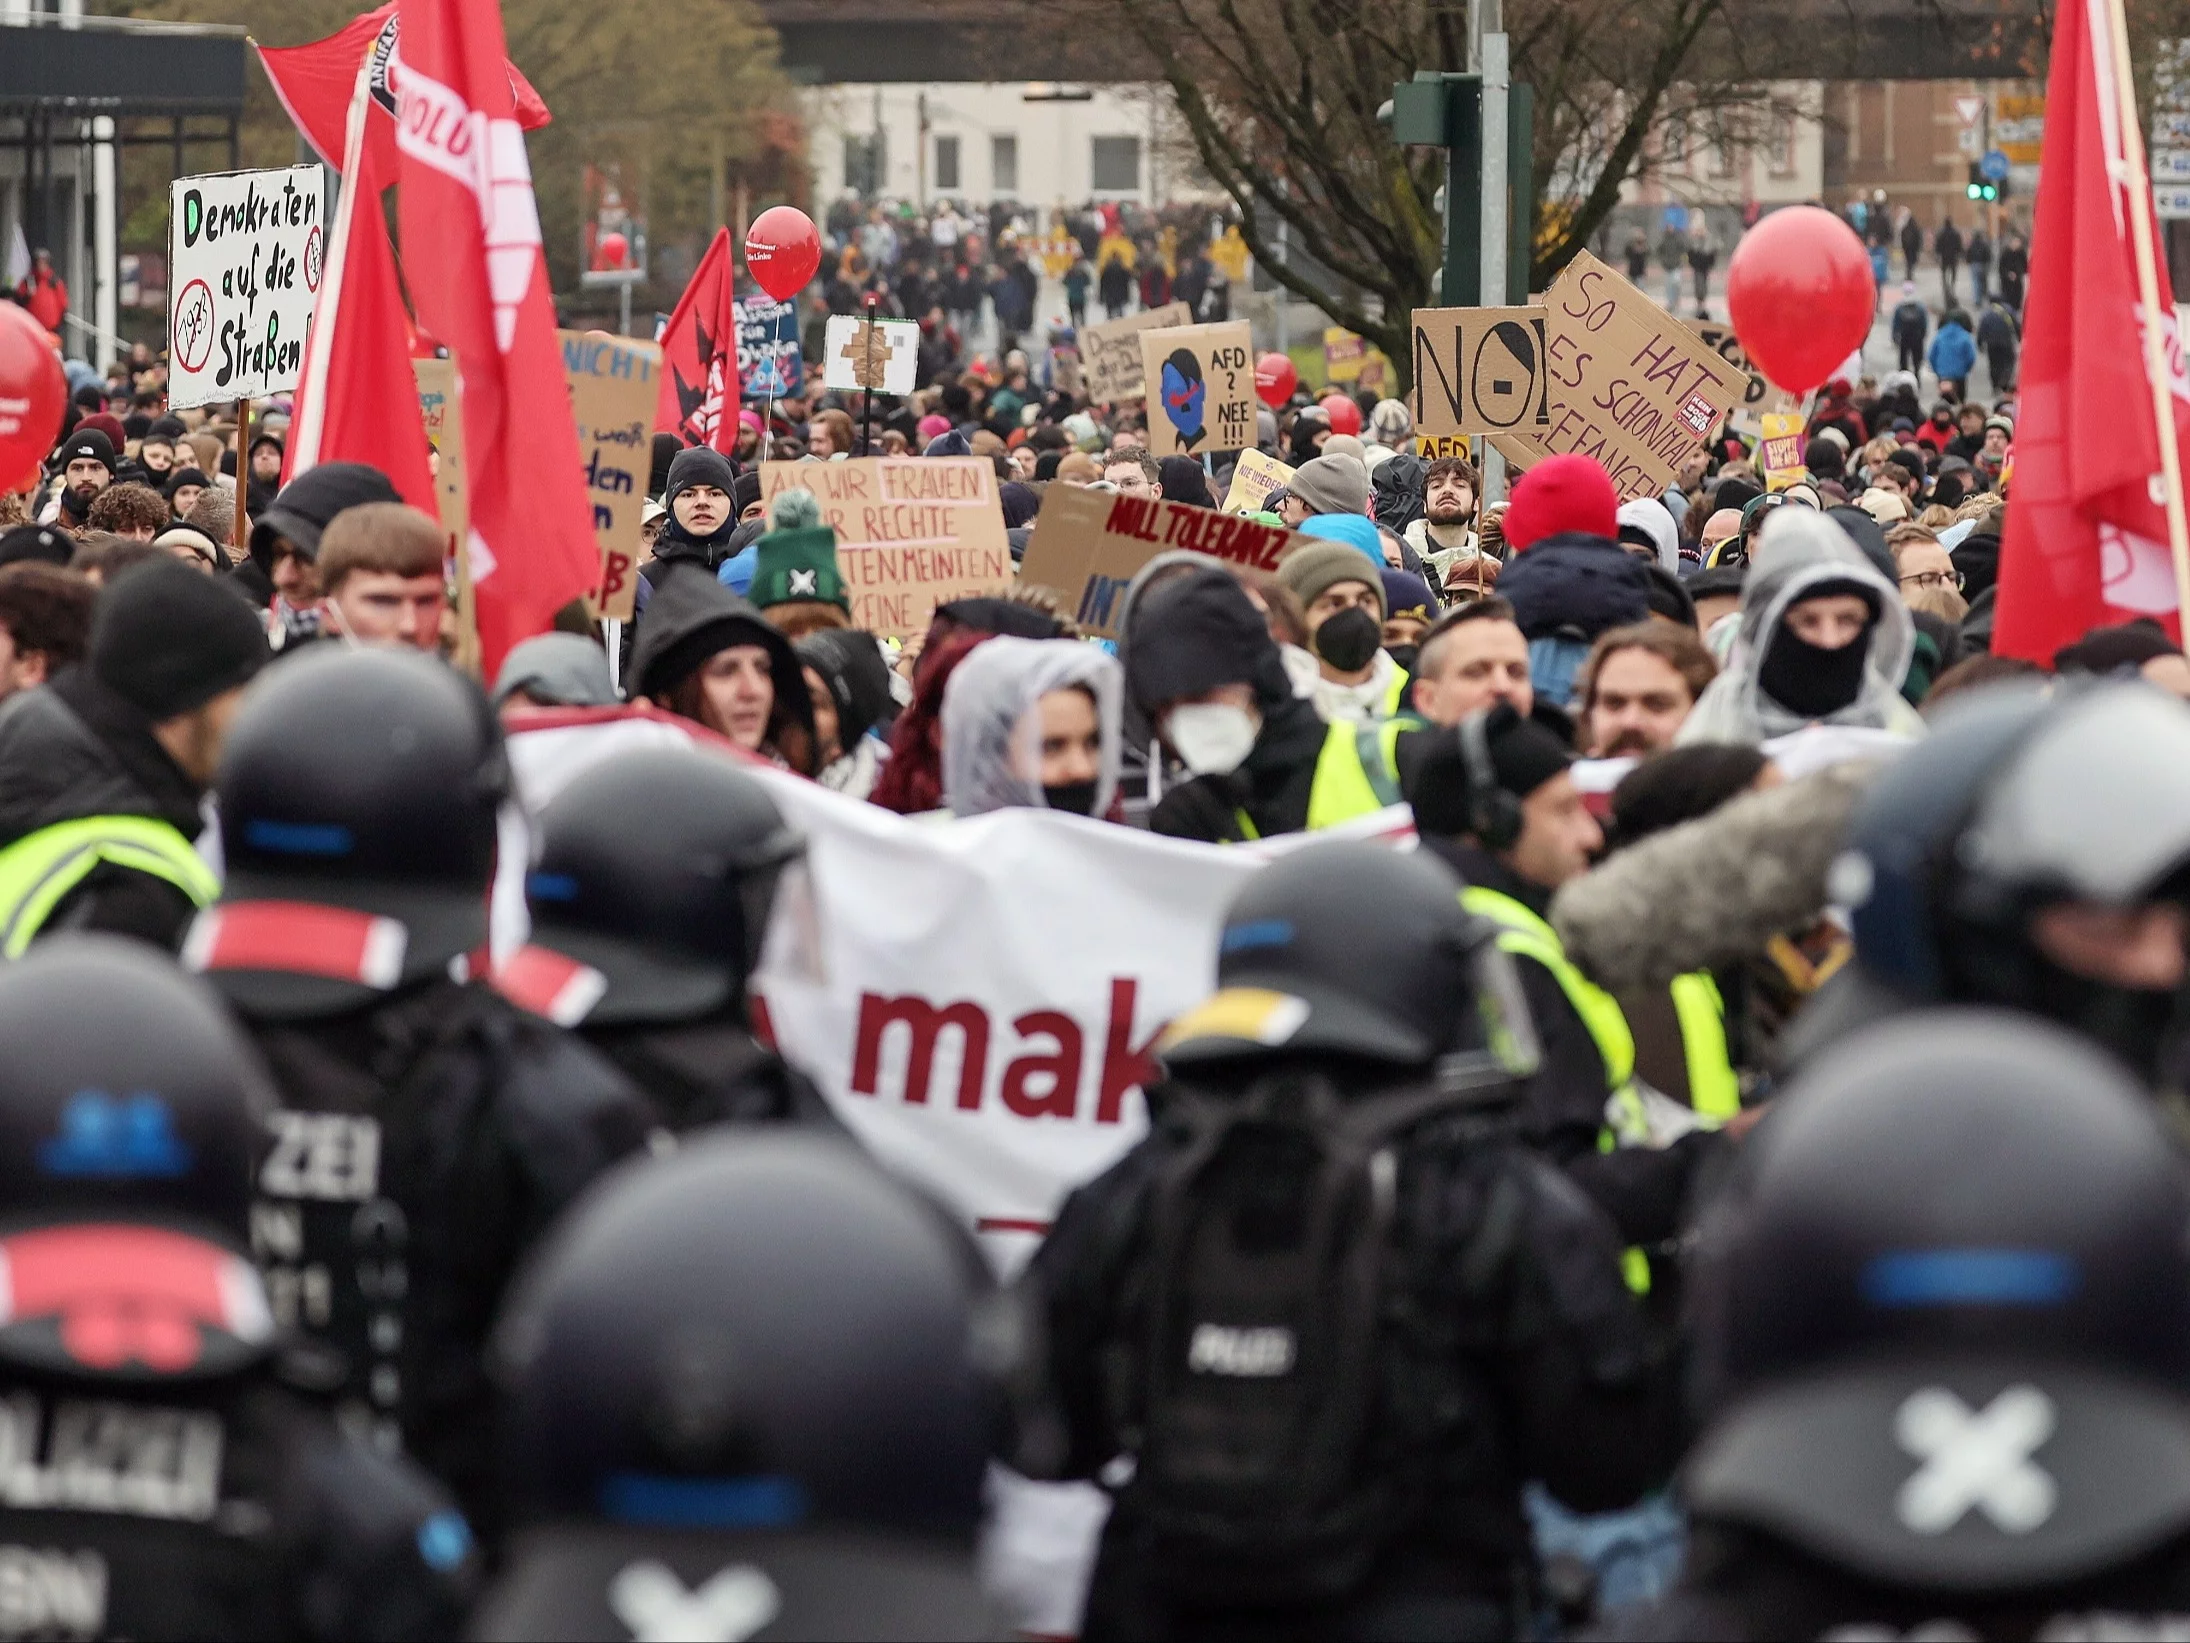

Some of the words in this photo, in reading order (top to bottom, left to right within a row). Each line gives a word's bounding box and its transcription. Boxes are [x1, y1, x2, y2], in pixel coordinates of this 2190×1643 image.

[184, 175, 316, 248] Demokraten
[222, 242, 259, 319] auf
[265, 241, 295, 292] die
[216, 310, 301, 390] Straßen
[1562, 271, 1616, 332] SO
[1630, 333, 1724, 405] HAT
[1211, 347, 1246, 371] AFD
[1416, 318, 1550, 428] NO!
[1549, 333, 1593, 388] ES
[1226, 372, 1236, 399] ?
[1218, 401, 1250, 424] NEE
[1686, 404, 1712, 424] BOCK
[1691, 396, 1713, 414] KEIN
[1223, 424, 1244, 446] !!!
[823, 468, 868, 500] WIR
[882, 464, 980, 499] FRAUEN
[1239, 464, 1253, 480] NIE
[863, 505, 959, 541] RECHTE
[1105, 495, 1160, 542] NULL
[1164, 504, 1292, 572] TOLERANZ
